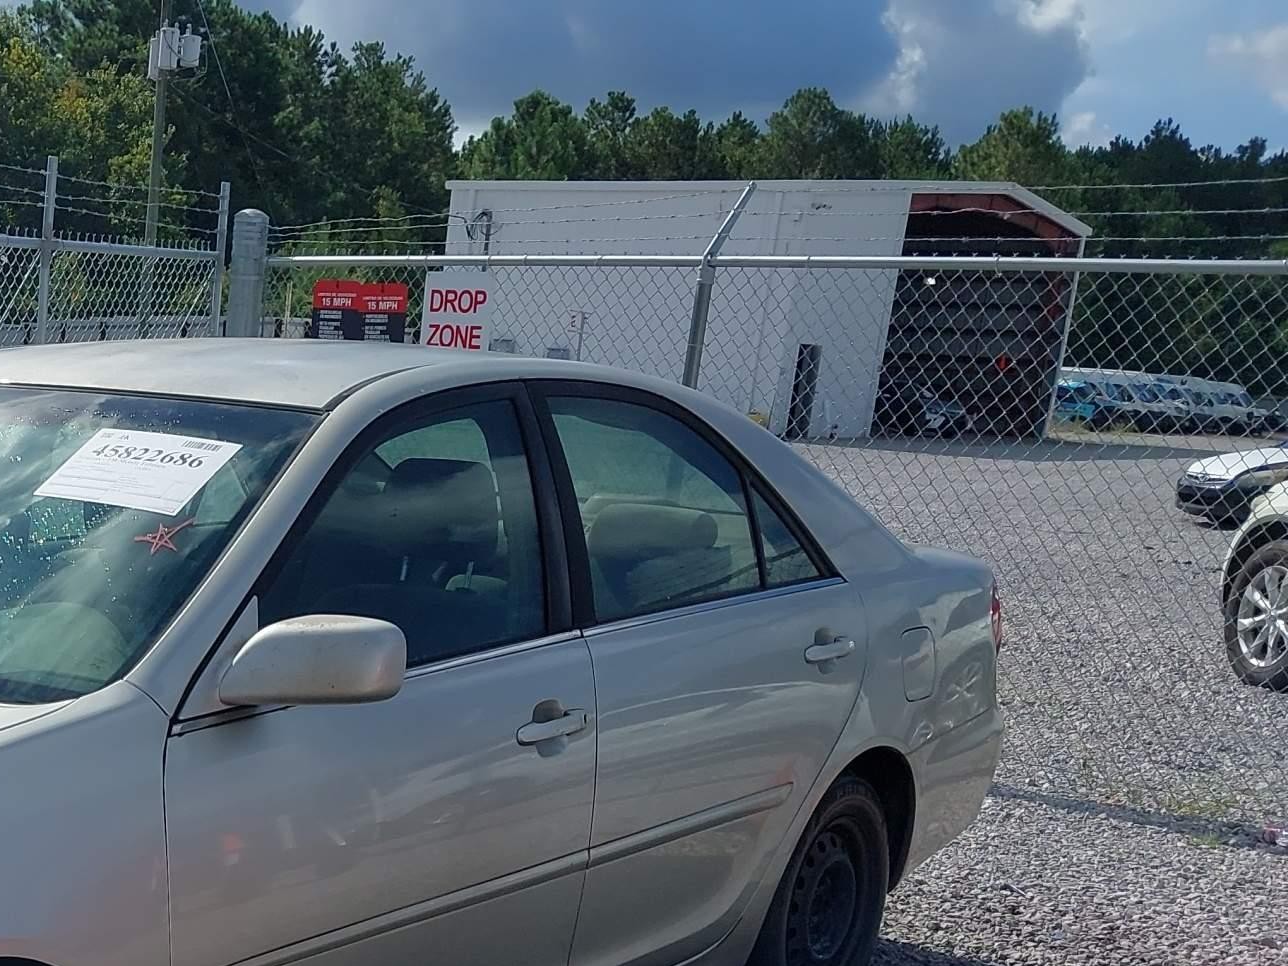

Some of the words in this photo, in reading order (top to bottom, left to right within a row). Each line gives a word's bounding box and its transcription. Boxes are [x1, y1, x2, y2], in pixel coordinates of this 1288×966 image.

[322, 297, 331, 307] 15
[332, 297, 352, 307] MPH
[367, 301, 377, 311] 15
[378, 301, 398, 311] MPH
[429, 289, 487, 313] DROP
[426, 324, 482, 349] ZONE
[92, 444, 208, 469] 45822686
